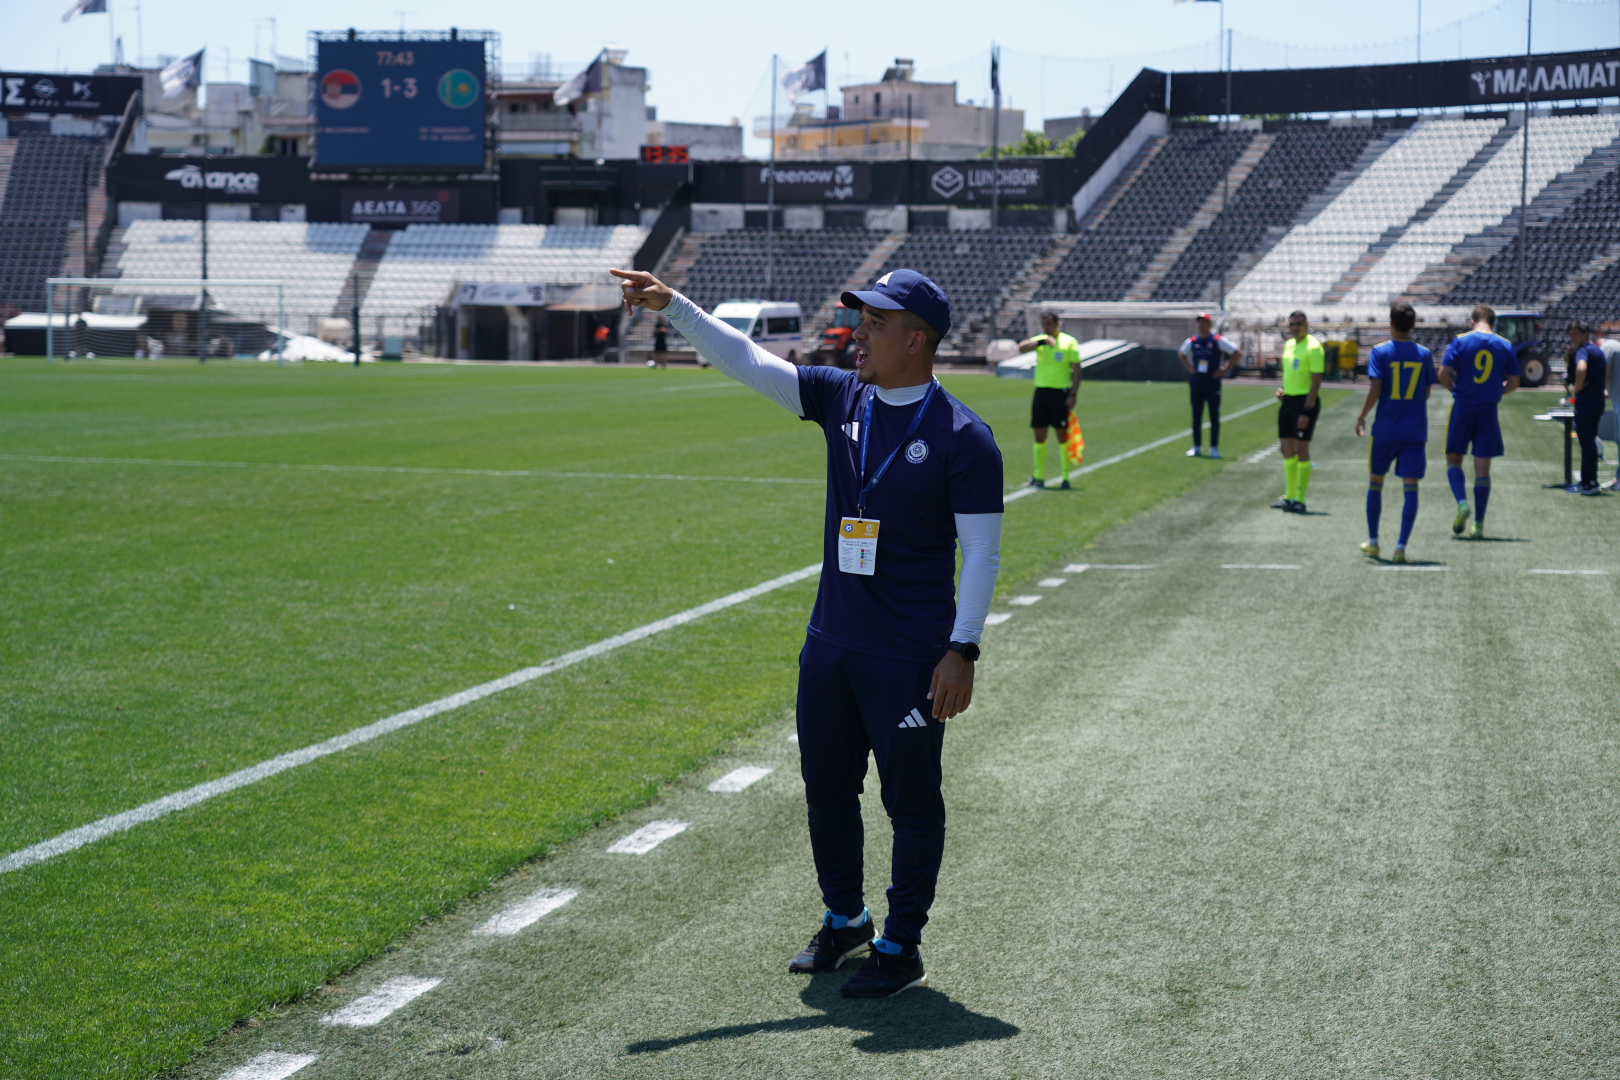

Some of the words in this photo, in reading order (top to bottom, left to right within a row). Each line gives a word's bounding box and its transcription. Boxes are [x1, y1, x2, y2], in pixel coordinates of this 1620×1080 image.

[376, 51, 414, 66] 77:43
[409, 201, 442, 216] 360
[1473, 349, 1494, 384] 9
[1389, 361, 1423, 400] 17
